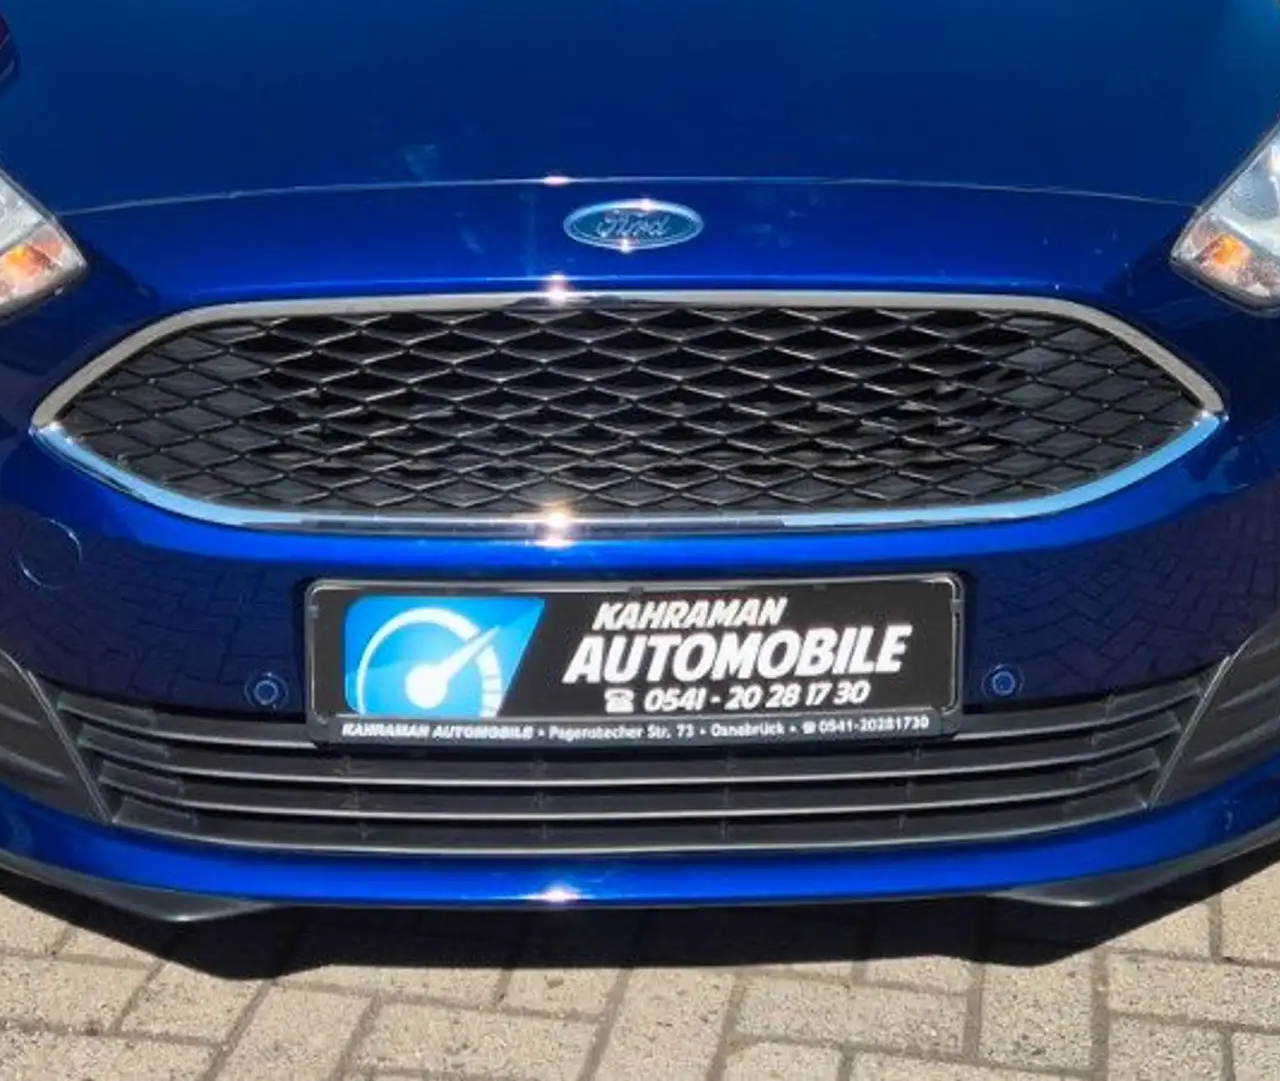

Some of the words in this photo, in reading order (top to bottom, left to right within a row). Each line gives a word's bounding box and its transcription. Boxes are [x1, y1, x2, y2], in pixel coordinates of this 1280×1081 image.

[595, 209, 671, 238] Ford
[591, 595, 789, 632] KAHRAMAN
[561, 623, 913, 685] AUTOMOBILE
[643, 687, 708, 713] 0541
[723, 683, 764, 710] 20
[765, 682, 801, 709] 28
[804, 681, 833, 707] 17
[833, 680, 871, 705] 30
[342, 723, 430, 738] KAHRAMAN
[432, 724, 535, 740] AUTOMOBILE
[647, 723, 671, 739] Str.
[676, 723, 695, 738] 73
[710, 720, 785, 738] Osnabrück
